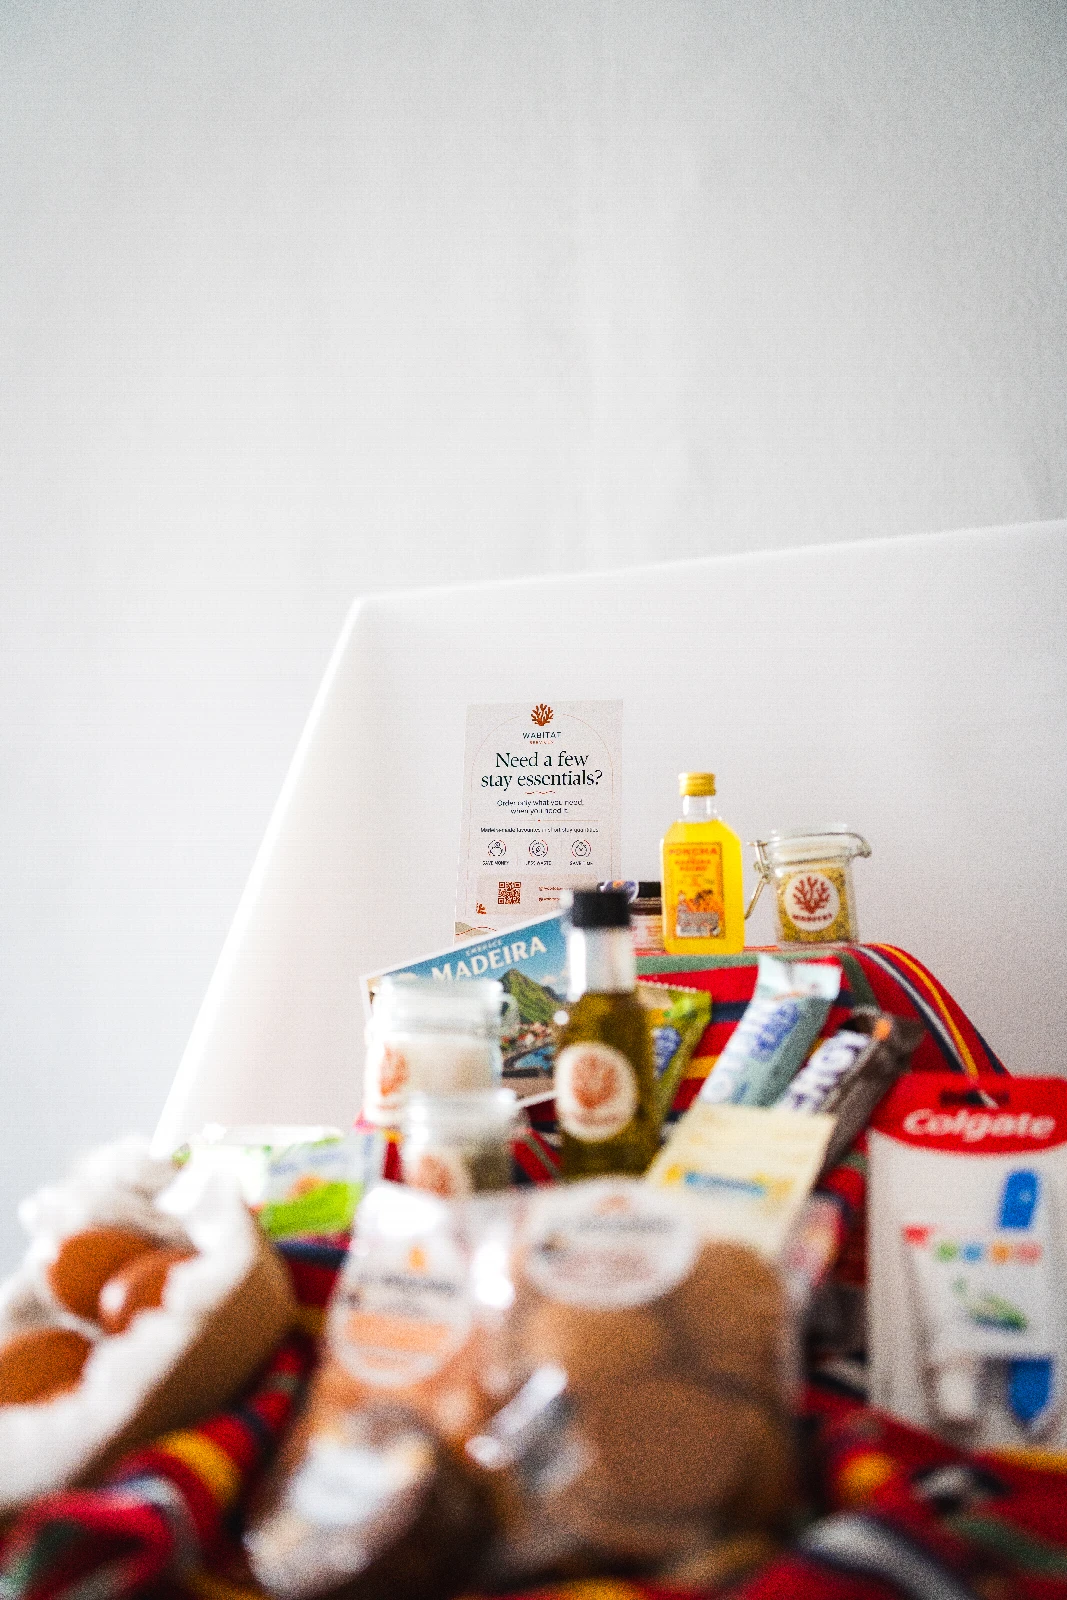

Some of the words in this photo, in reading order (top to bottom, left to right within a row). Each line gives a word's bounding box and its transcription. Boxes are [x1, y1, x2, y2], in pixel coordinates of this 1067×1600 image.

[522, 731, 562, 740] WABITAT
[495, 751, 538, 768] Need
[543, 755, 553, 767] a
[558, 750, 590, 767] few
[481, 774, 513, 791] stay
[517, 769, 603, 787] essentials?
[497, 799, 516, 807] Order
[431, 936, 548, 981] MADEIRA
[902, 1107, 1057, 1144] Colgate
